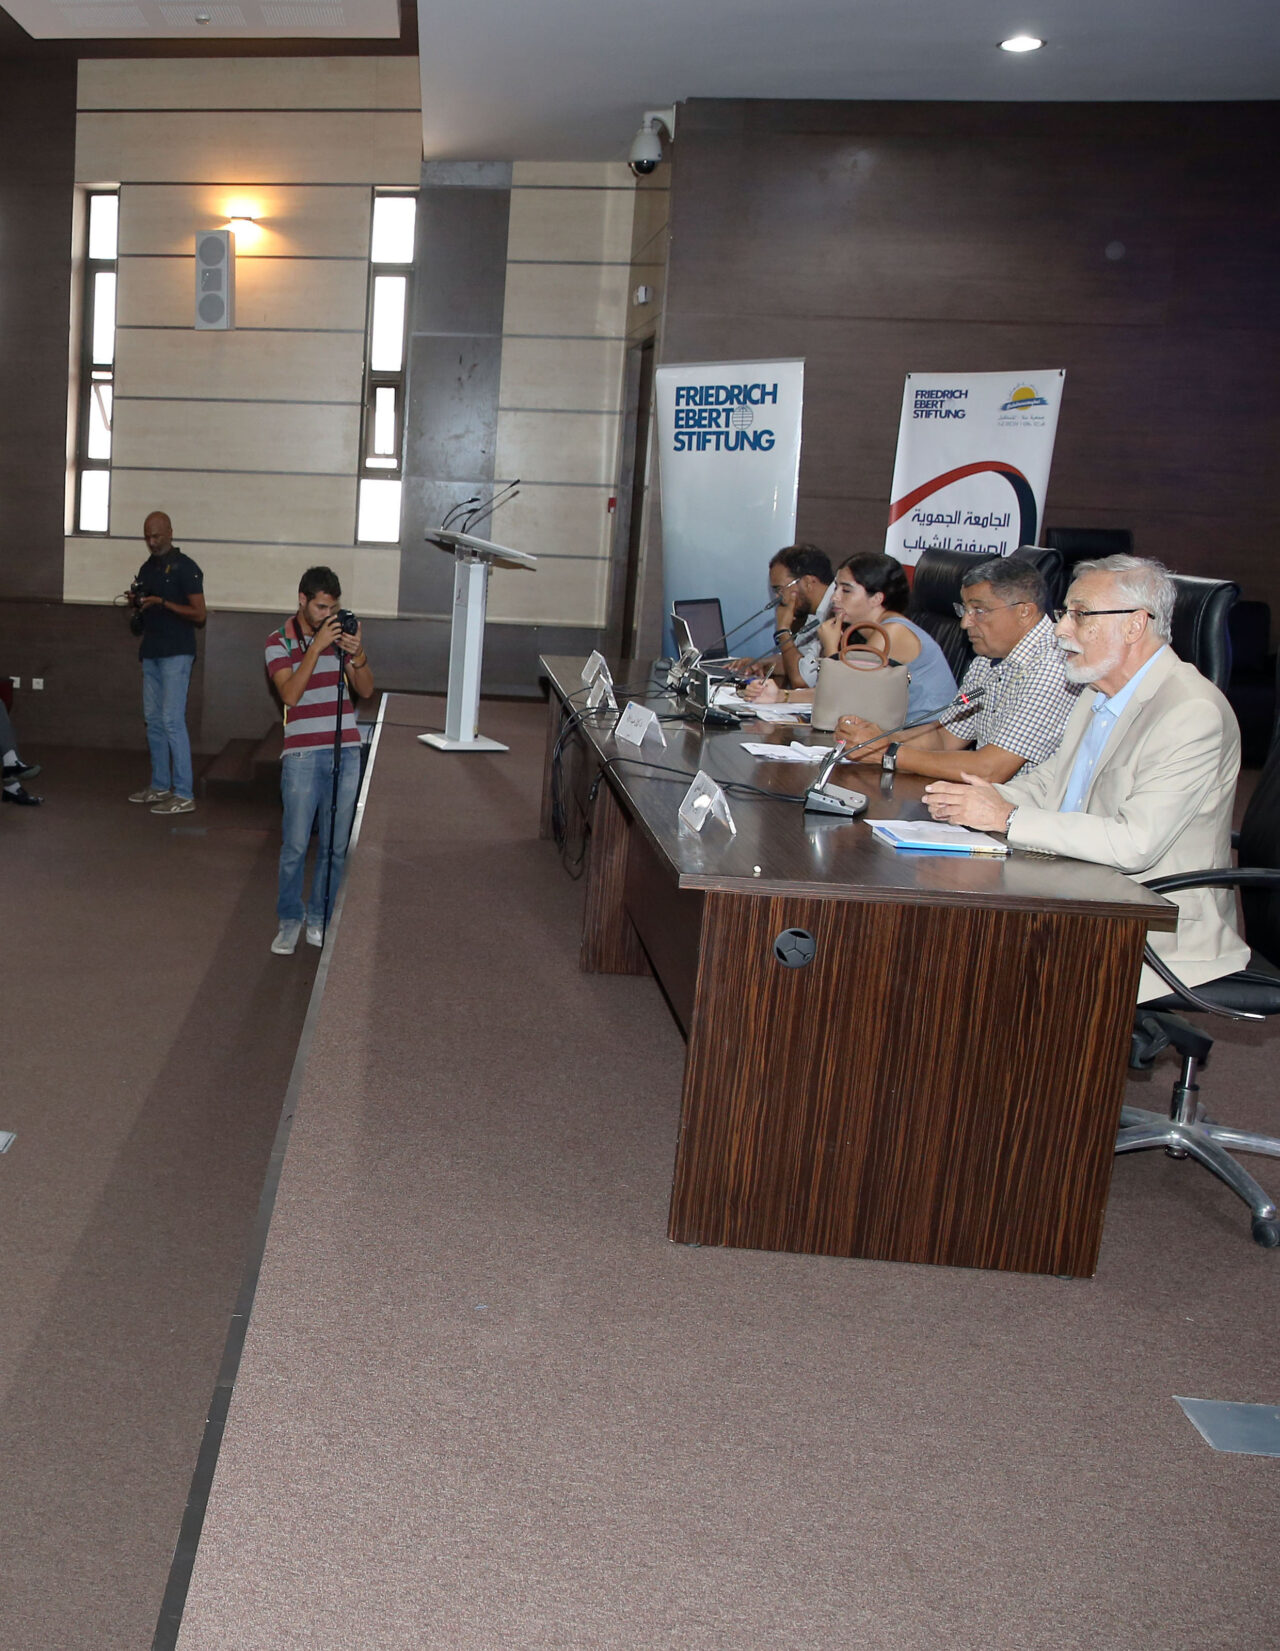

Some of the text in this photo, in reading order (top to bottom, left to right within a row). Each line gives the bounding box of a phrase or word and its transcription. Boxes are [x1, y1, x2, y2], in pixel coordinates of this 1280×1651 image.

[675, 383, 778, 406] FRIEDRICH
[914, 399, 945, 409] EBERT
[915, 389, 969, 399] FRIEDRICH
[674, 407, 735, 429] EBERT
[913, 409, 966, 419] STIFTUNG
[673, 429, 776, 452] STIFTUNG
[911, 508, 1011, 531] الجامعة الجهوية
